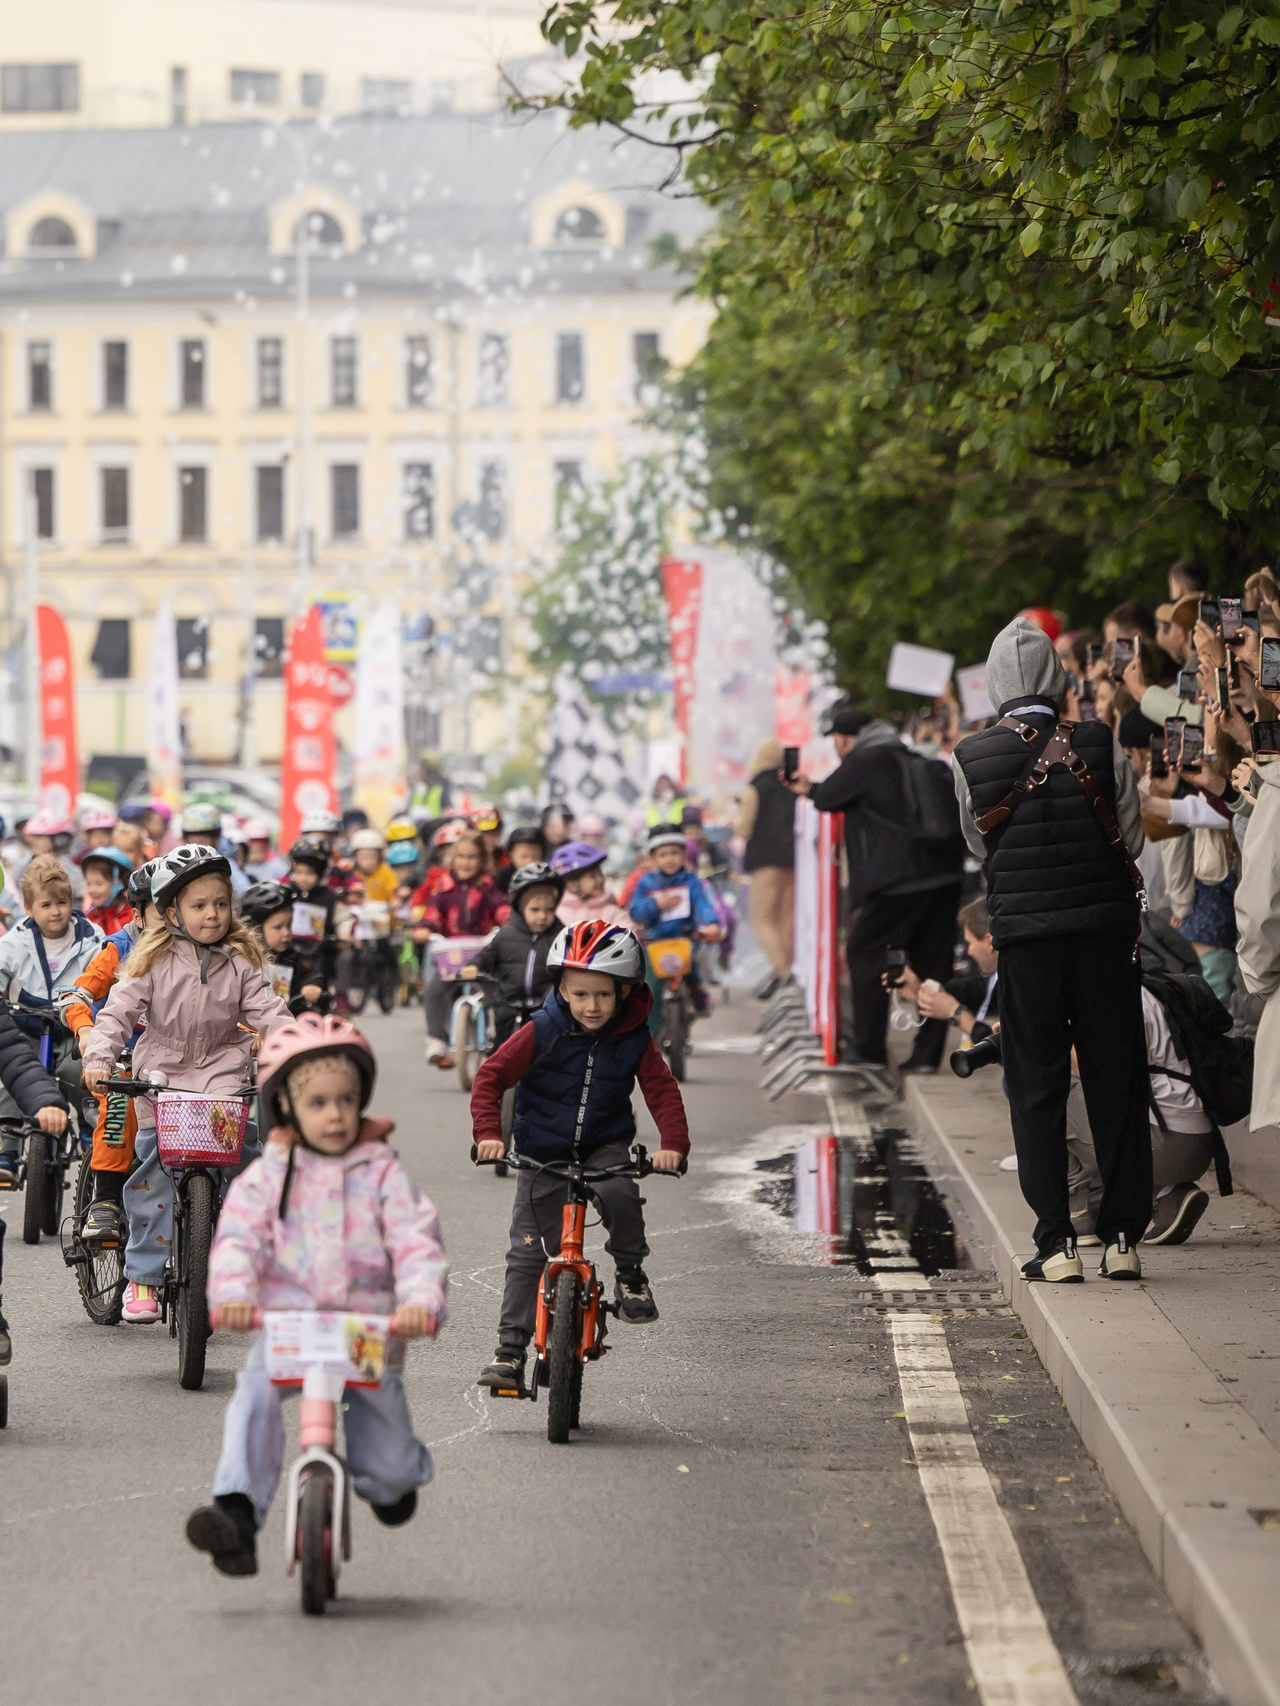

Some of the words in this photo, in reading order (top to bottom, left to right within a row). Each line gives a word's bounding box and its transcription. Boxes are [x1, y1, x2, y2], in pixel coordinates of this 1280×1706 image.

[584, 1068, 592, 1085] GUESS
[581, 1086, 589, 1104] GUESS
[577, 1106, 585, 1124] GUESS
